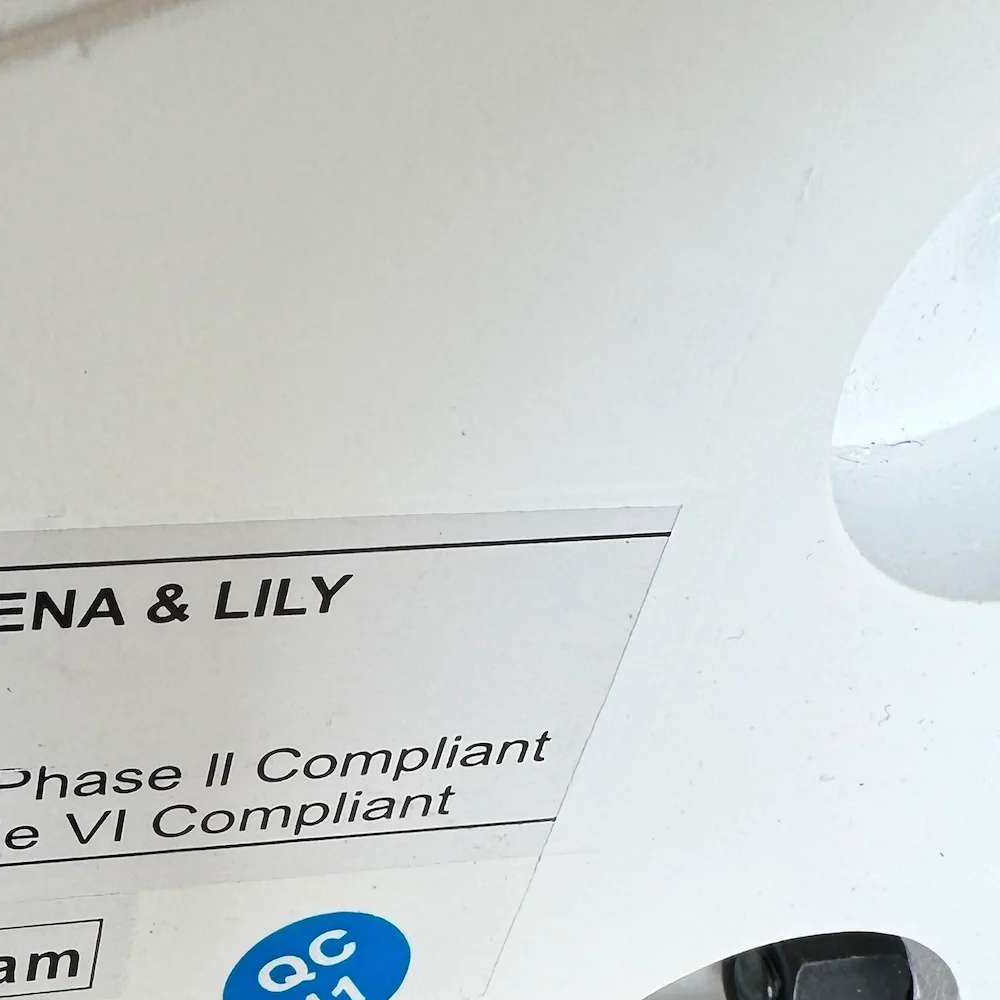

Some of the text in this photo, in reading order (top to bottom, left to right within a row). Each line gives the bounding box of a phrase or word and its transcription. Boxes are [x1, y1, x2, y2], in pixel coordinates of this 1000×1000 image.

[147, 583, 190, 623] &
[214, 574, 354, 620] LILY
[205, 752, 233, 788] II
[256, 730, 552, 782] Compliant
[66, 809, 126, 845] VI
[152, 785, 456, 836] Compliant
[257, 929, 357, 993] QC
